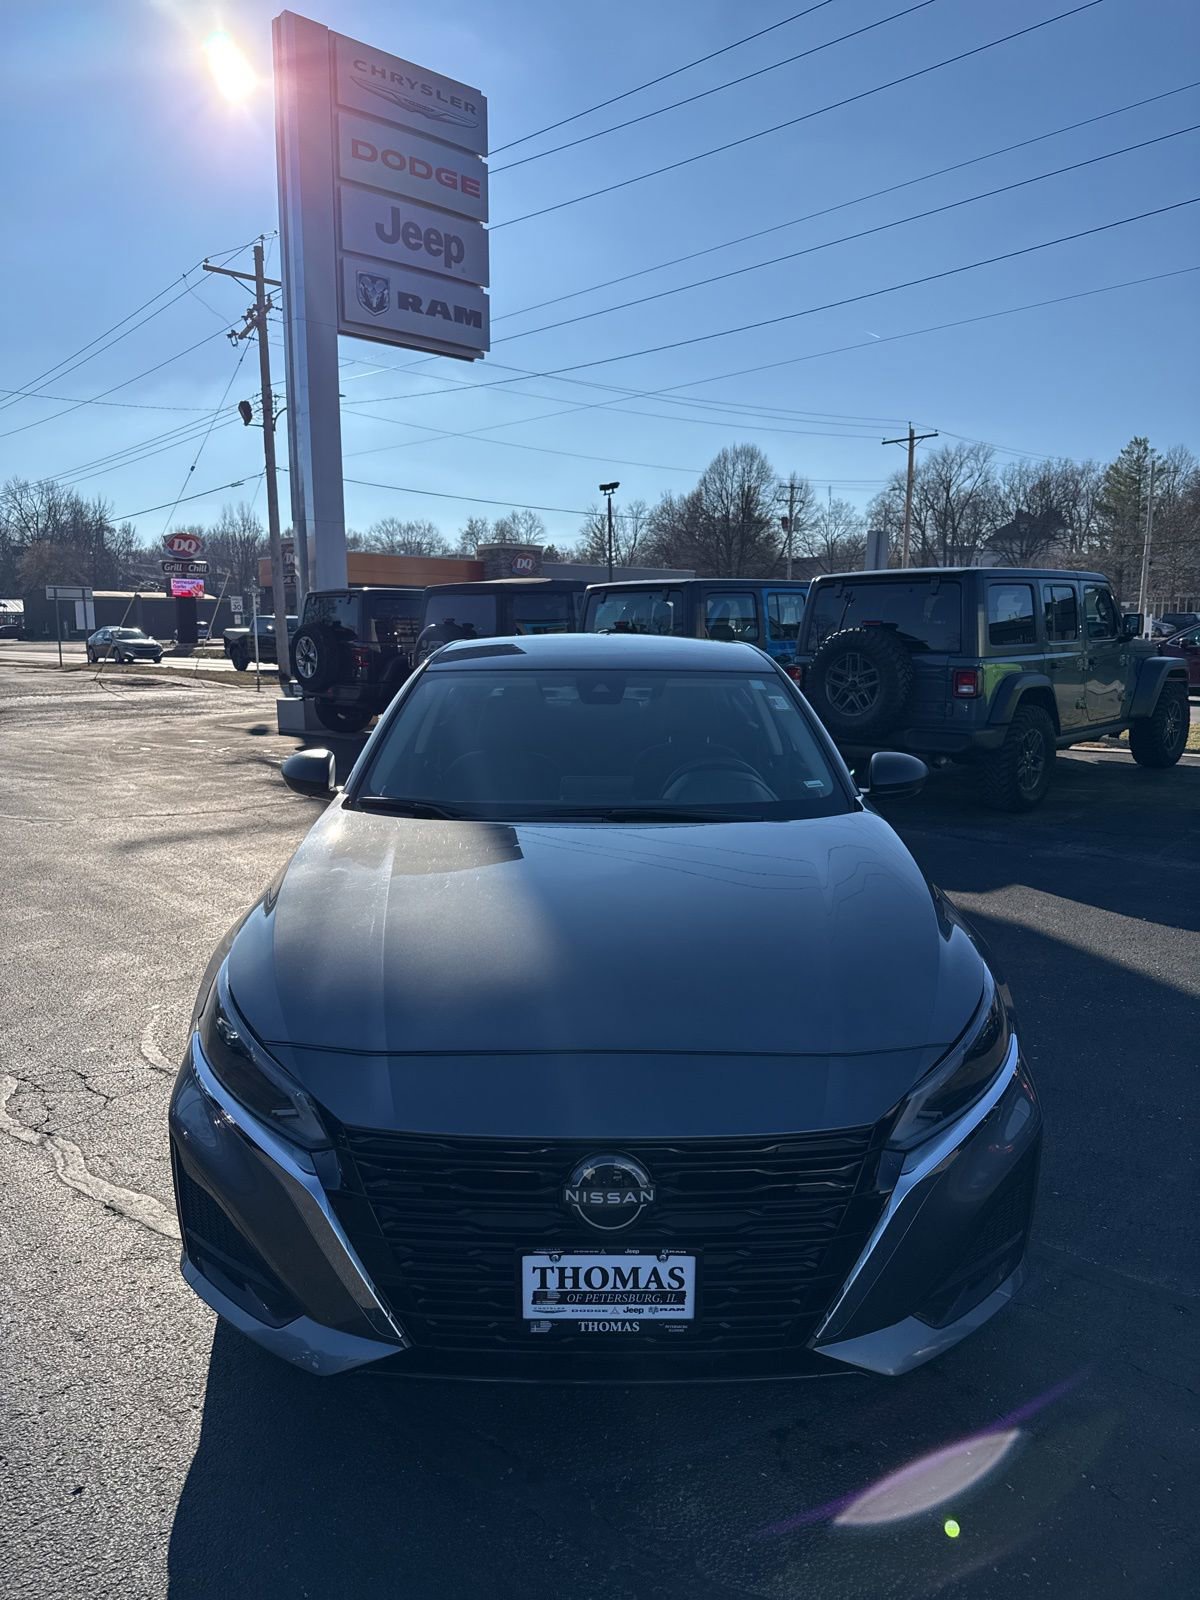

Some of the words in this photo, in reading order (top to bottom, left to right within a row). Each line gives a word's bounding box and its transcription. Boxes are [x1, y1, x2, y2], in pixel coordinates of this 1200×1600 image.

[353, 59, 476, 115] CHRYSLER
[351, 138, 481, 199] DODGE
[375, 206, 465, 269] Jeep
[397, 291, 482, 329] RAM
[173, 538, 197, 553] DQ
[163, 563, 183, 572] Grill
[188, 564, 207, 573] Chill
[517, 558, 532, 570] DQ
[565, 1189, 654, 1204] NISSAN
[532, 1266, 686, 1290] THOMAS
[566, 1293, 583, 1303] OF
[584, 1293, 663, 1304] PETERSBURG,
[665, 1293, 677, 1303] IL
[623, 1306, 644, 1314] Jeep
[578, 1321, 640, 1332] THOMAS
